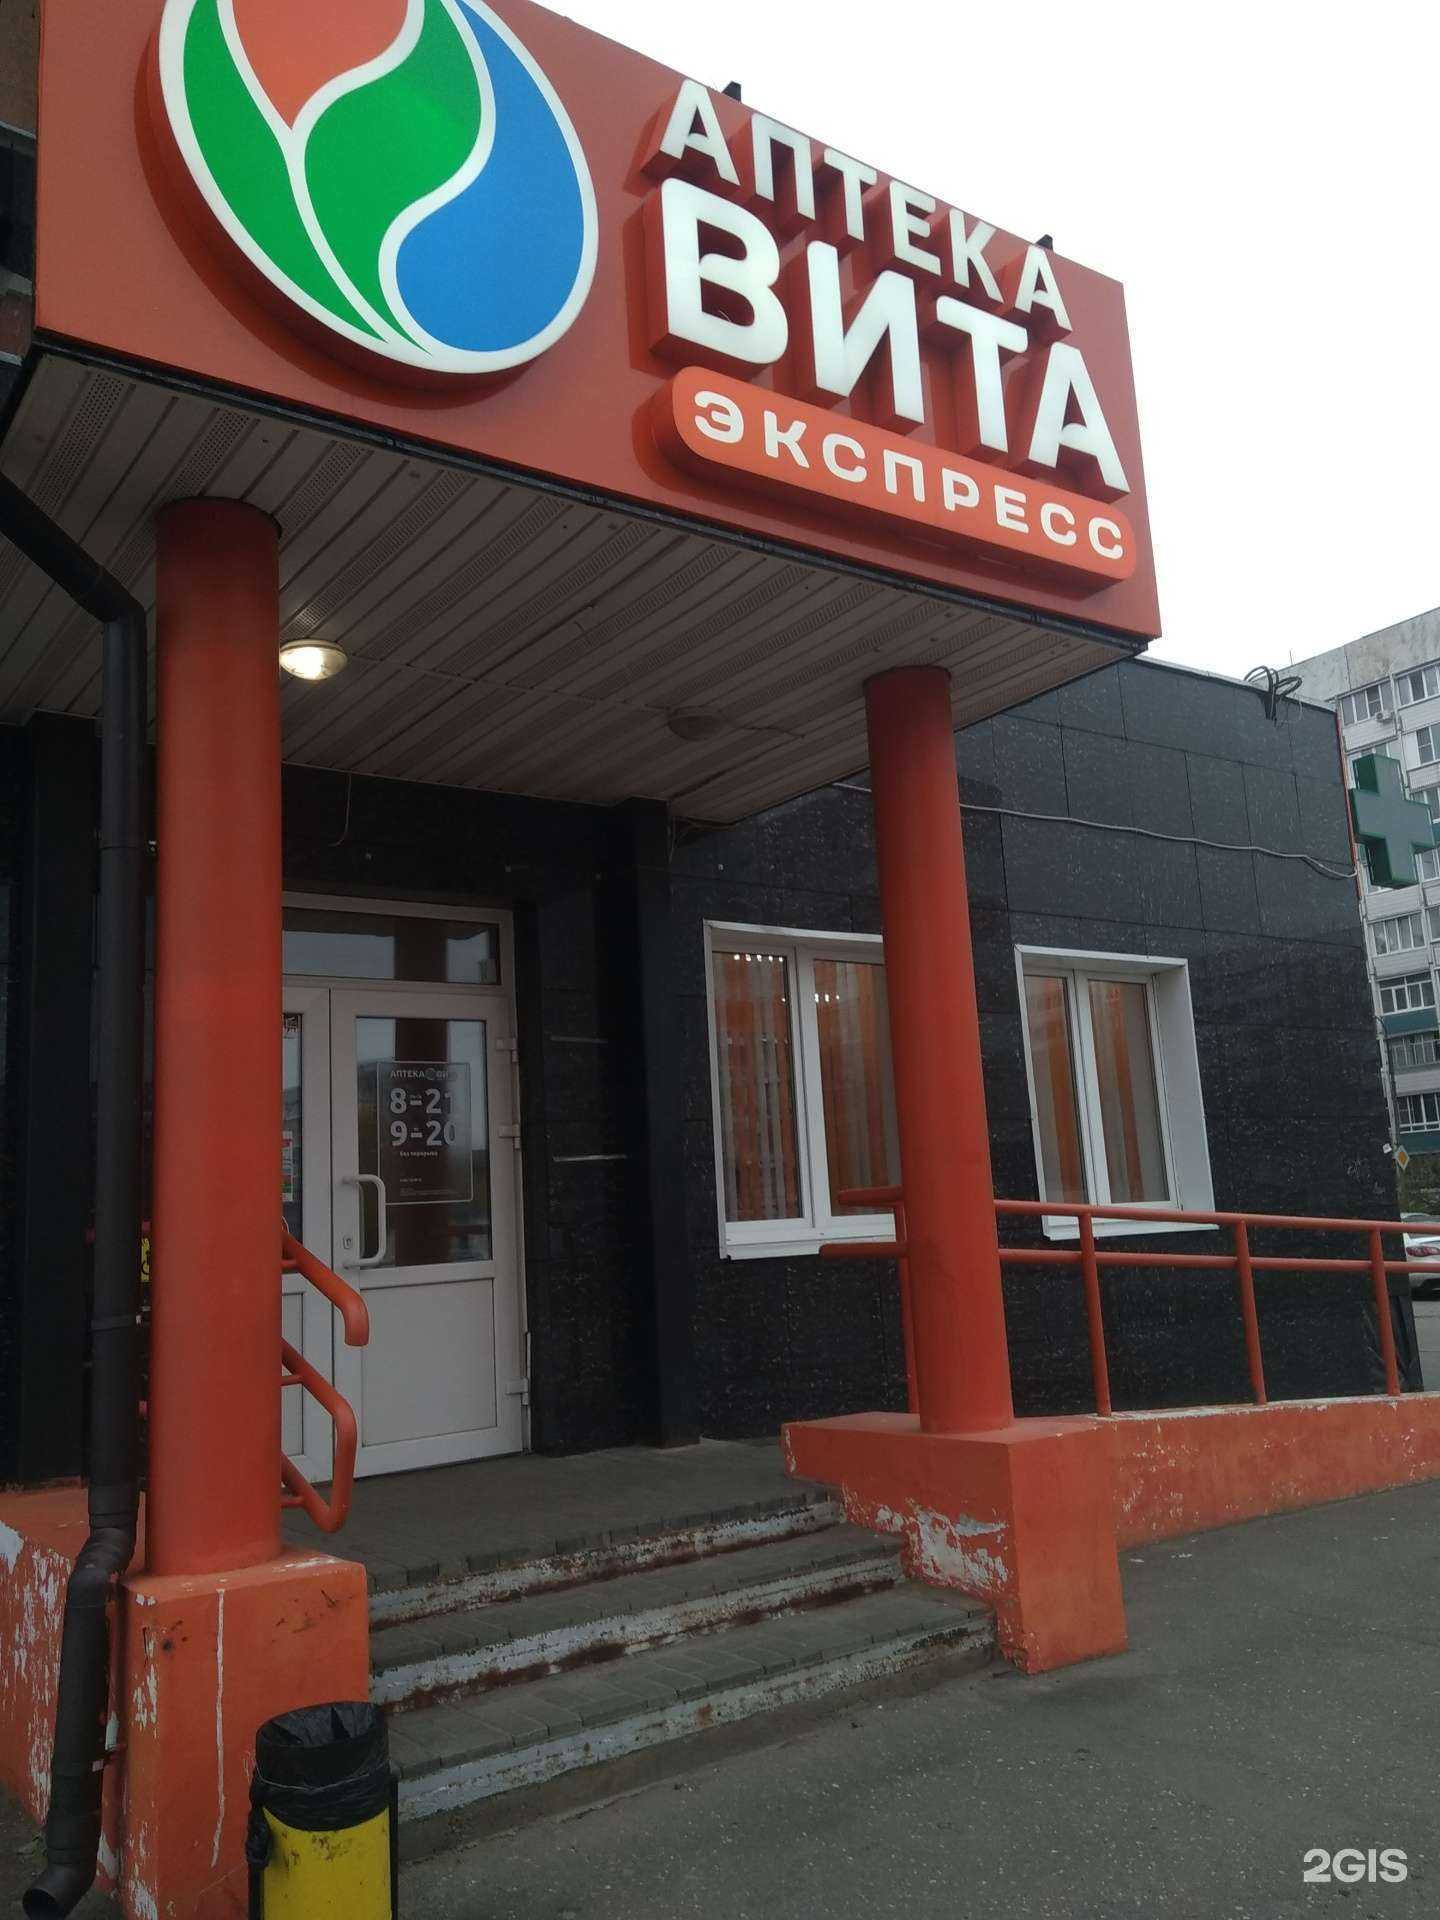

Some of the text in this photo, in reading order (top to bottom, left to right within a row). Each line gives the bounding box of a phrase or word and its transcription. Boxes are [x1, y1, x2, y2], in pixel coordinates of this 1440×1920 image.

[660, 79, 1072, 333] АПТЕКА
[661, 177, 1131, 493] ВИТА
[694, 389, 1125, 560] ЭКСПРЕСС
